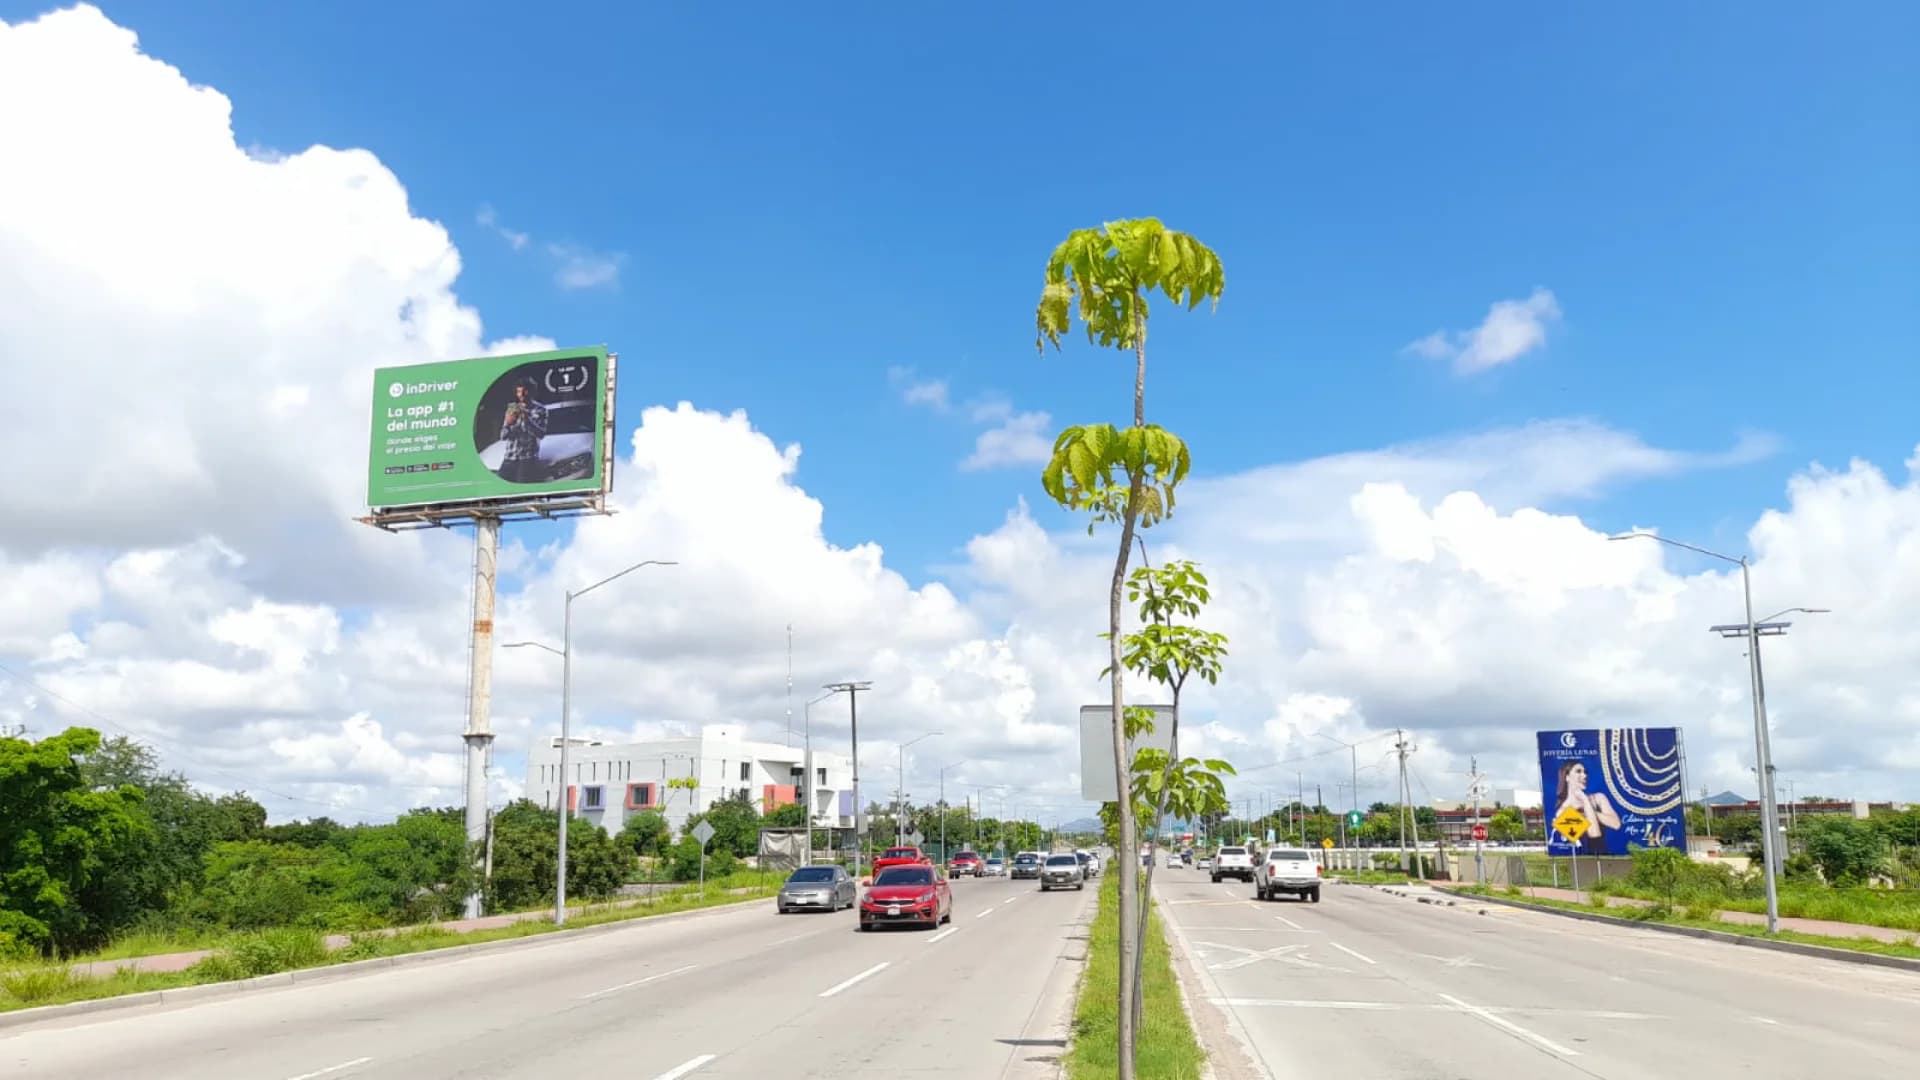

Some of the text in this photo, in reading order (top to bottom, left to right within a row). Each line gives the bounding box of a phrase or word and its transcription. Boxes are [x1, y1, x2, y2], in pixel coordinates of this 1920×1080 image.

[562, 373, 569, 384] 1
[406, 381, 458, 394] inDriver
[387, 400, 454, 418] La app #1
[386, 415, 457, 432] del mundo
